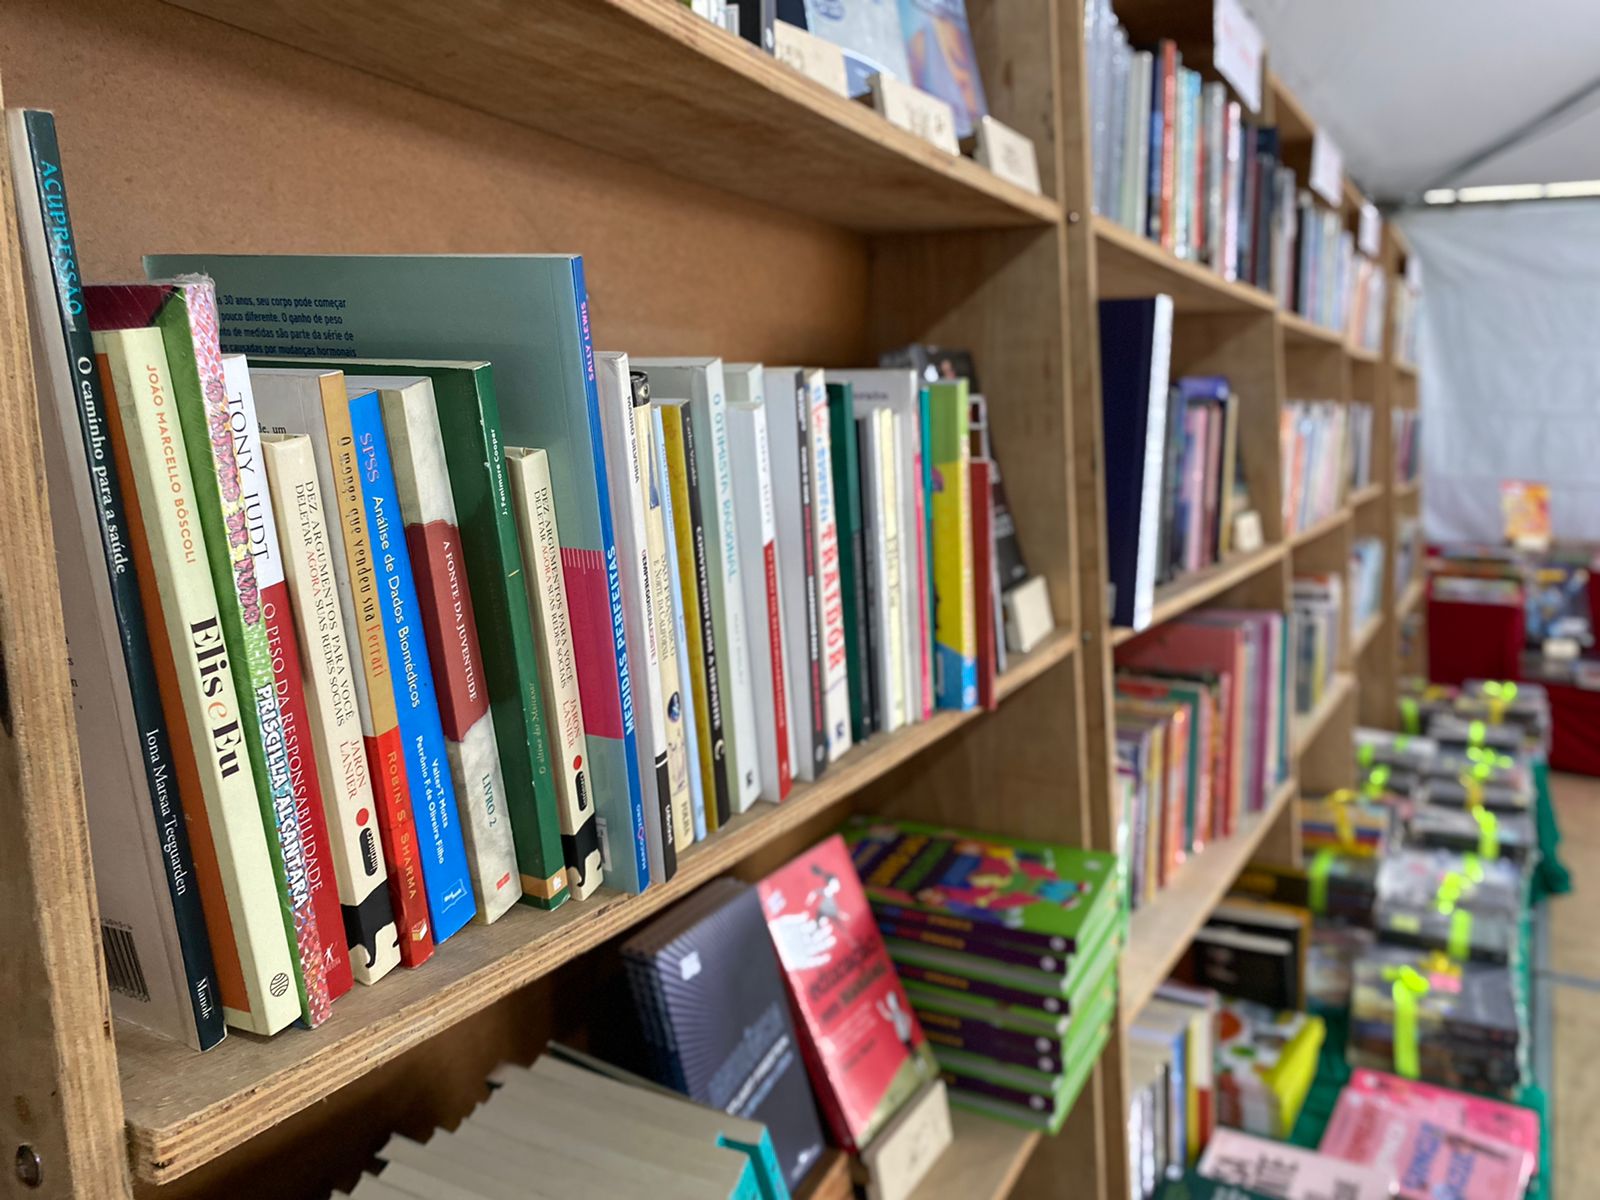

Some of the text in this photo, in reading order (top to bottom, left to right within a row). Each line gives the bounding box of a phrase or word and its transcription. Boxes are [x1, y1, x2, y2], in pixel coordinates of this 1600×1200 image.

[41, 160, 82, 315] ACUPRESSÃO
[221, 312, 243, 322] pouco
[282, 314, 287, 322] O
[289, 314, 312, 324] ganho
[314, 314, 322, 323] de
[325, 316, 342, 325] peso
[224, 295, 232, 304] 30
[271, 298, 292, 307] corpo
[295, 298, 312, 308] pode
[314, 299, 346, 310] começar
[232, 328, 242, 336] de
[244, 328, 274, 338] medidas
[276, 328, 288, 338] são
[290, 330, 310, 340] parte
[312, 330, 320, 340] da
[323, 330, 342, 340] série
[344, 332, 354, 341] de
[230, 344, 262, 354] causadas
[265, 346, 276, 354] por
[278, 346, 315, 356] mudanças
[316, 348, 356, 358] hormonais
[580, 302, 594, 381] SALLY LEWIS
[78, 357, 128, 574] O caminho para a saúde
[146, 364, 196, 564] JOÃO MARCELLO BÔSCOLI
[272, 426, 287, 434] um
[490, 428, 500, 462] Cooper
[228, 392, 270, 560] TONY JUDT
[496, 462, 506, 506] Fenimore
[226, 507, 250, 548] DE
[346, 507, 362, 534] que
[354, 540, 372, 594] vendeu
[363, 597, 375, 622] sua
[234, 550, 260, 627] TUDO
[295, 484, 345, 727] DELETAR AGORA SUAS REDES SOCIAIS
[304, 481, 354, 722] DEZ ARGUMENTOS PARA VOCÊ
[360, 432, 421, 708] SPSS Análise de Dados Biomédicos
[534, 490, 567, 690] DELETAR AGORA SUAS REDES SOCIAIS
[541, 487, 574, 684] DEZ ARGUMENTOS PARA VOCÊ
[443, 541, 478, 702] A FONTE DA JUVENTUDE
[608, 545, 635, 736] MEDIDAS PERFEITAS
[190, 616, 242, 780] Elis e Eu
[562, 700, 575, 748] LANIER
[570, 698, 582, 738] JARON
[263, 603, 323, 894] O PESO DA RESPONSABILIDADE
[339, 741, 358, 800] LANIER
[350, 740, 366, 789] JARON
[416, 735, 428, 779] Petrônio
[146, 728, 188, 896] Iona Marsaa Teeguarden
[256, 683, 310, 910] PRISCILLA ALCANTARA
[388, 751, 402, 804] ROBIN
[400, 832, 417, 900] SHARMA
[426, 788, 434, 802] de
[428, 801, 440, 841] Oliveira
[432, 758, 441, 791] Valter
[438, 798, 449, 829] Motta
[482, 773, 498, 828] LIVRO 2
[435, 839, 445, 865] Filho
[196, 976, 210, 1020] Manole
